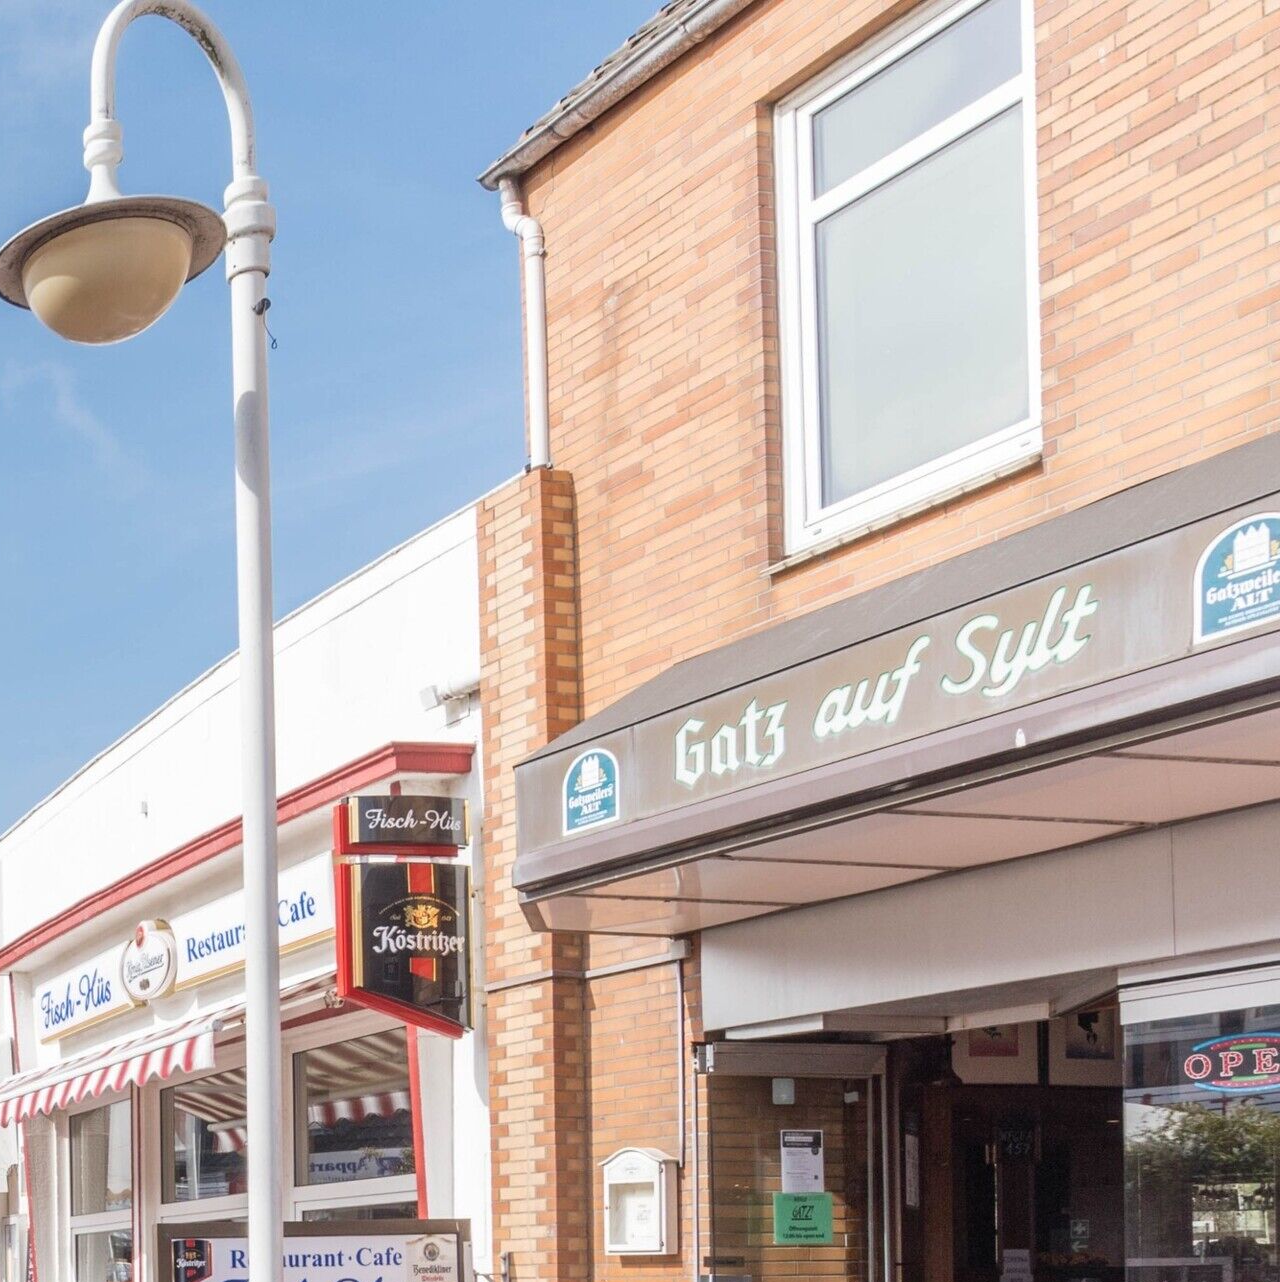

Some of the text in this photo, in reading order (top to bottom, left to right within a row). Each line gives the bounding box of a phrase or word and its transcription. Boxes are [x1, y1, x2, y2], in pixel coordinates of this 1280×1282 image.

[674, 583, 1099, 790] Gatz auf Sylt
[186, 891, 316, 962] Restaur Cafe
[372, 925, 465, 957] Köstritzer
[1183, 1047, 1280, 1080] OPE
[230, 1247, 403, 1270] Rurant Cafe
